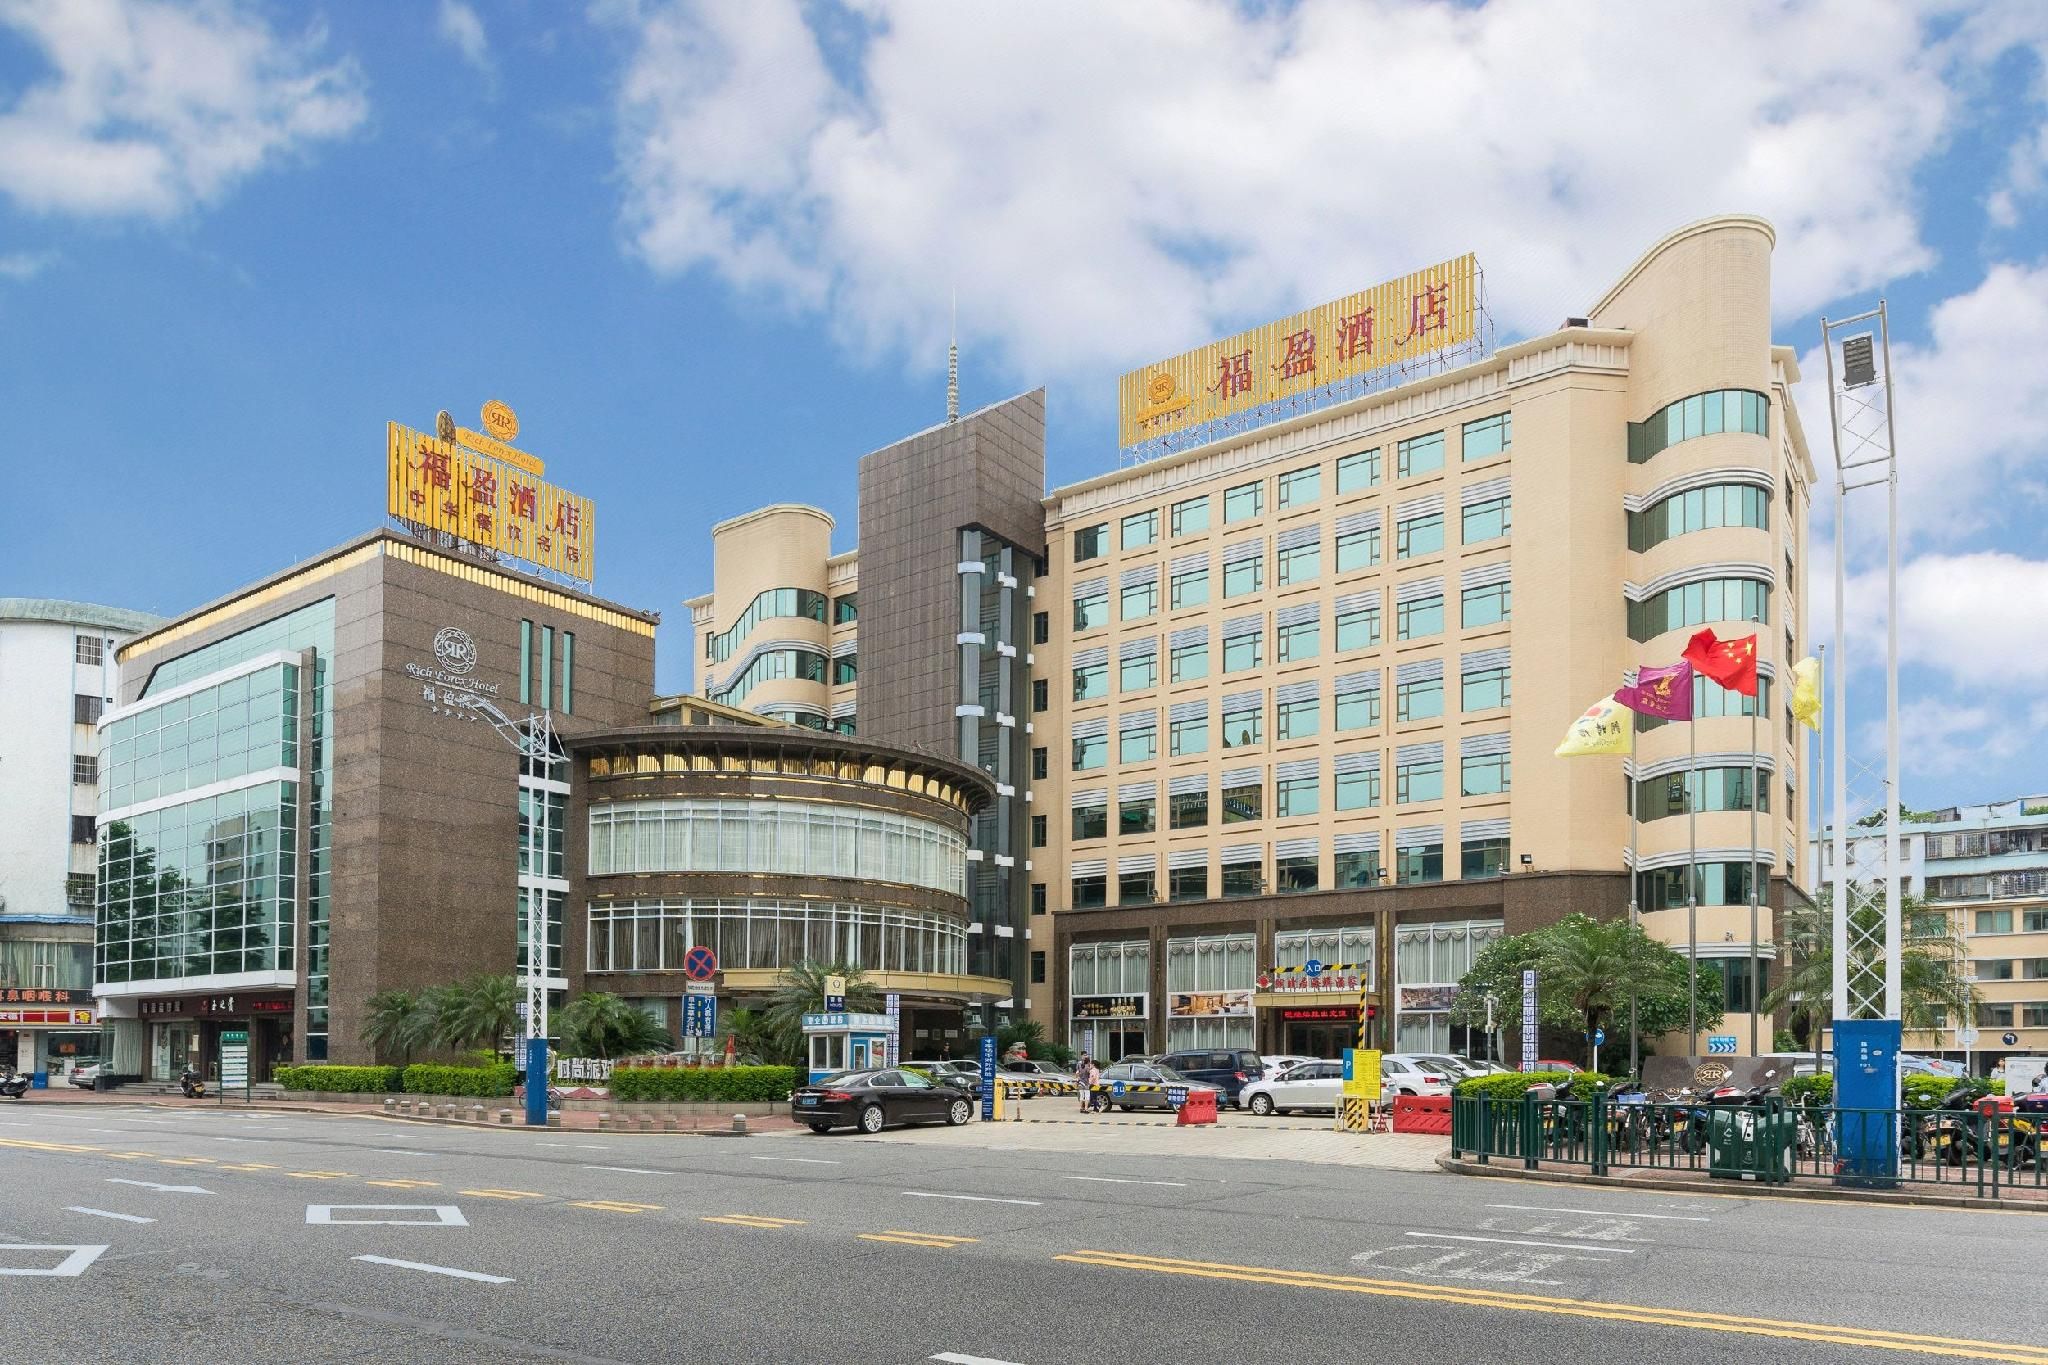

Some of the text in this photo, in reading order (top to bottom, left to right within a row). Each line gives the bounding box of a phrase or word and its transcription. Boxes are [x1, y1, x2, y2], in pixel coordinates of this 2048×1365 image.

[1207, 282, 1449, 400] 福盈酒店
[408, 444, 580, 540] 福盈酒店
[406, 662, 433, 677] Rich
[1345, 1060, 1352, 1070] P
